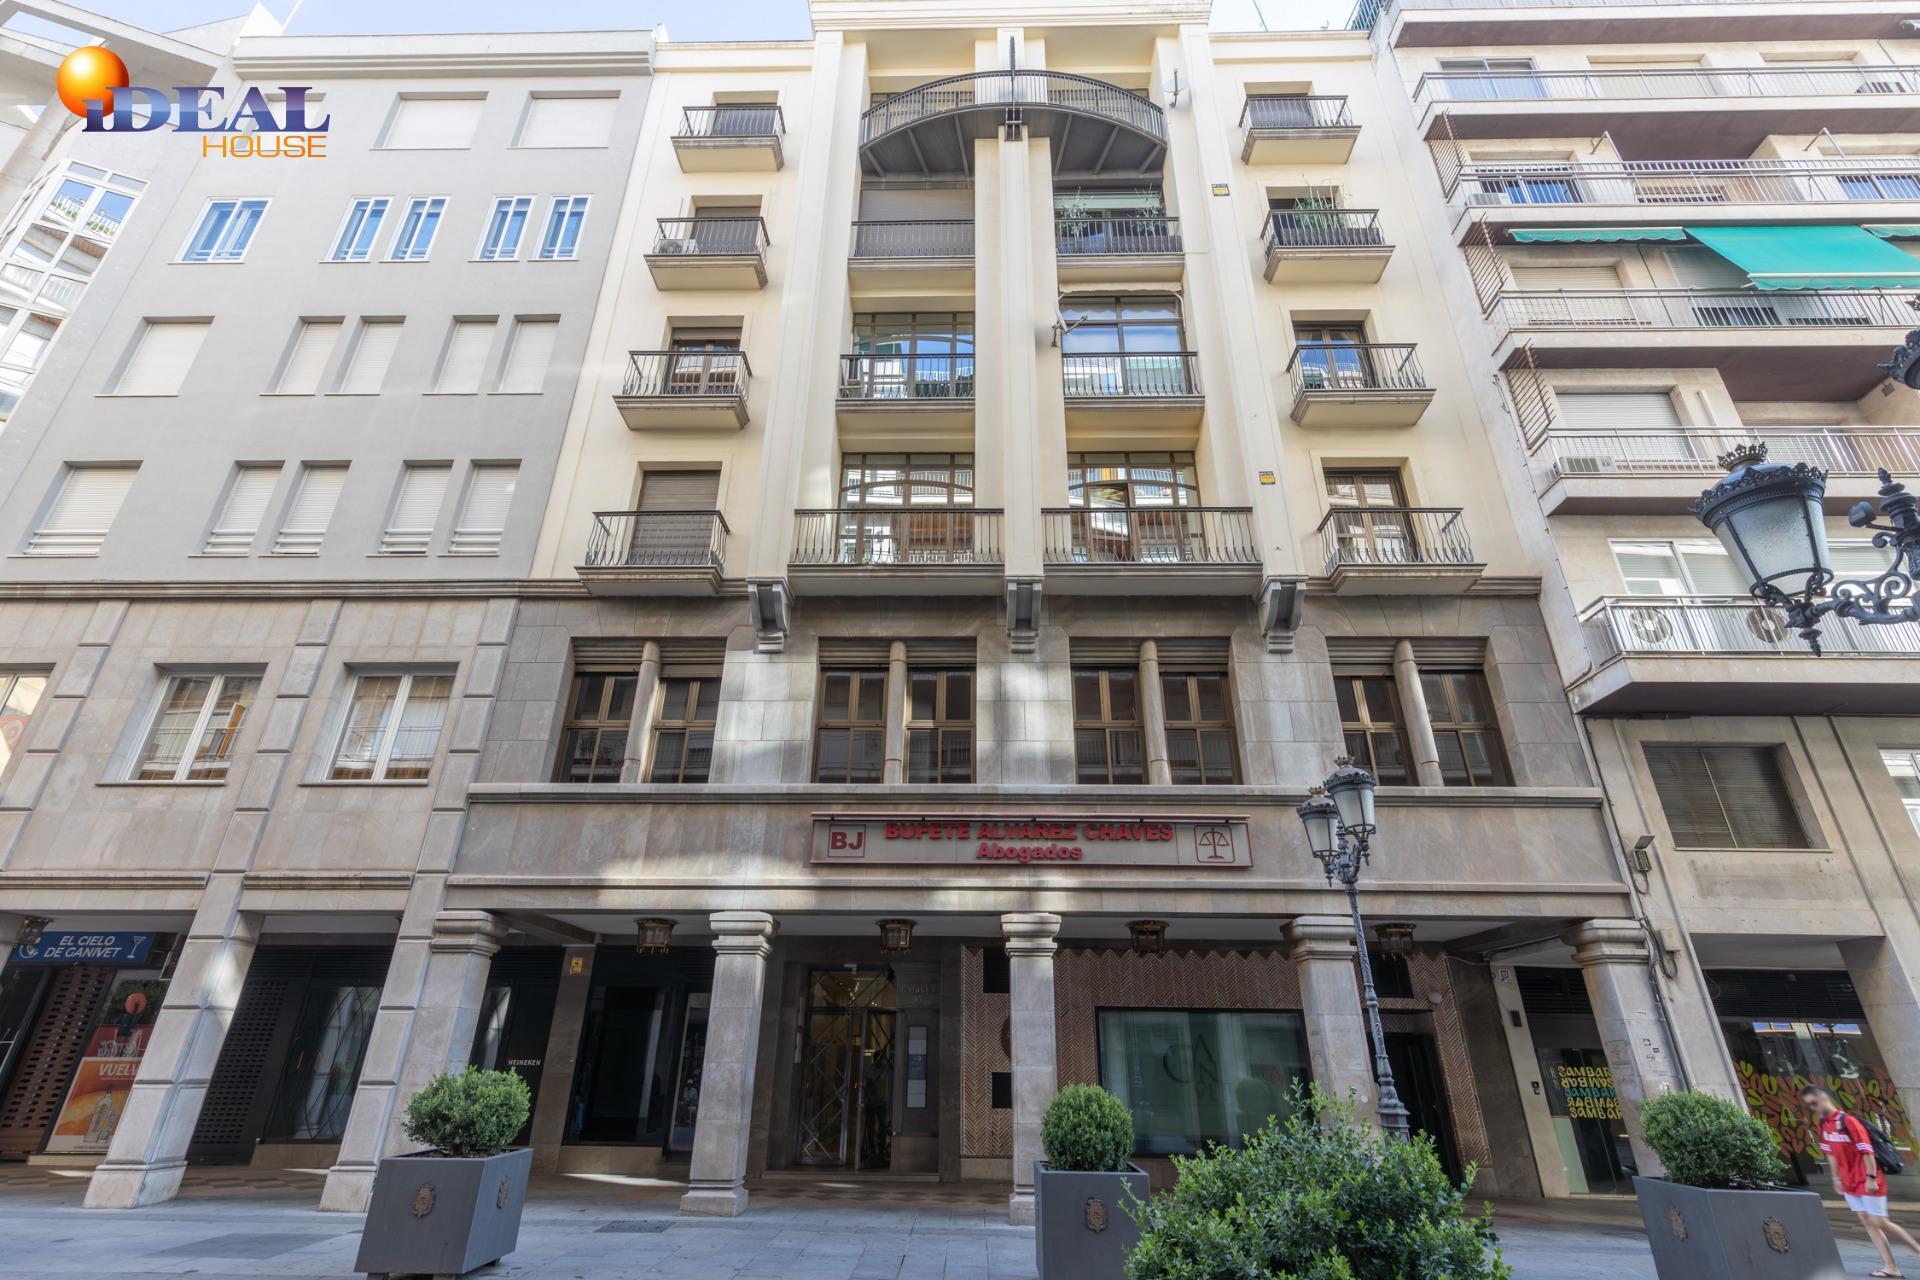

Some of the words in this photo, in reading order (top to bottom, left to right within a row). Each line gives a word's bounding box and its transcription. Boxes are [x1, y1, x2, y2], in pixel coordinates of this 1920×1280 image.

[885, 822, 970, 840] BUFETE
[977, 823, 1078, 840] ALVAREZ
[1083, 824, 1174, 841] CHAVES
[831, 831, 863, 850] BJ
[976, 842, 1083, 863] Abogados
[59, 936, 74, 946] EL
[78, 936, 115, 946] CIELO
[44, 947, 63, 958] DE
[64, 947, 122, 958] GANIVET
[1557, 1065, 1612, 1077] SAMBAR
